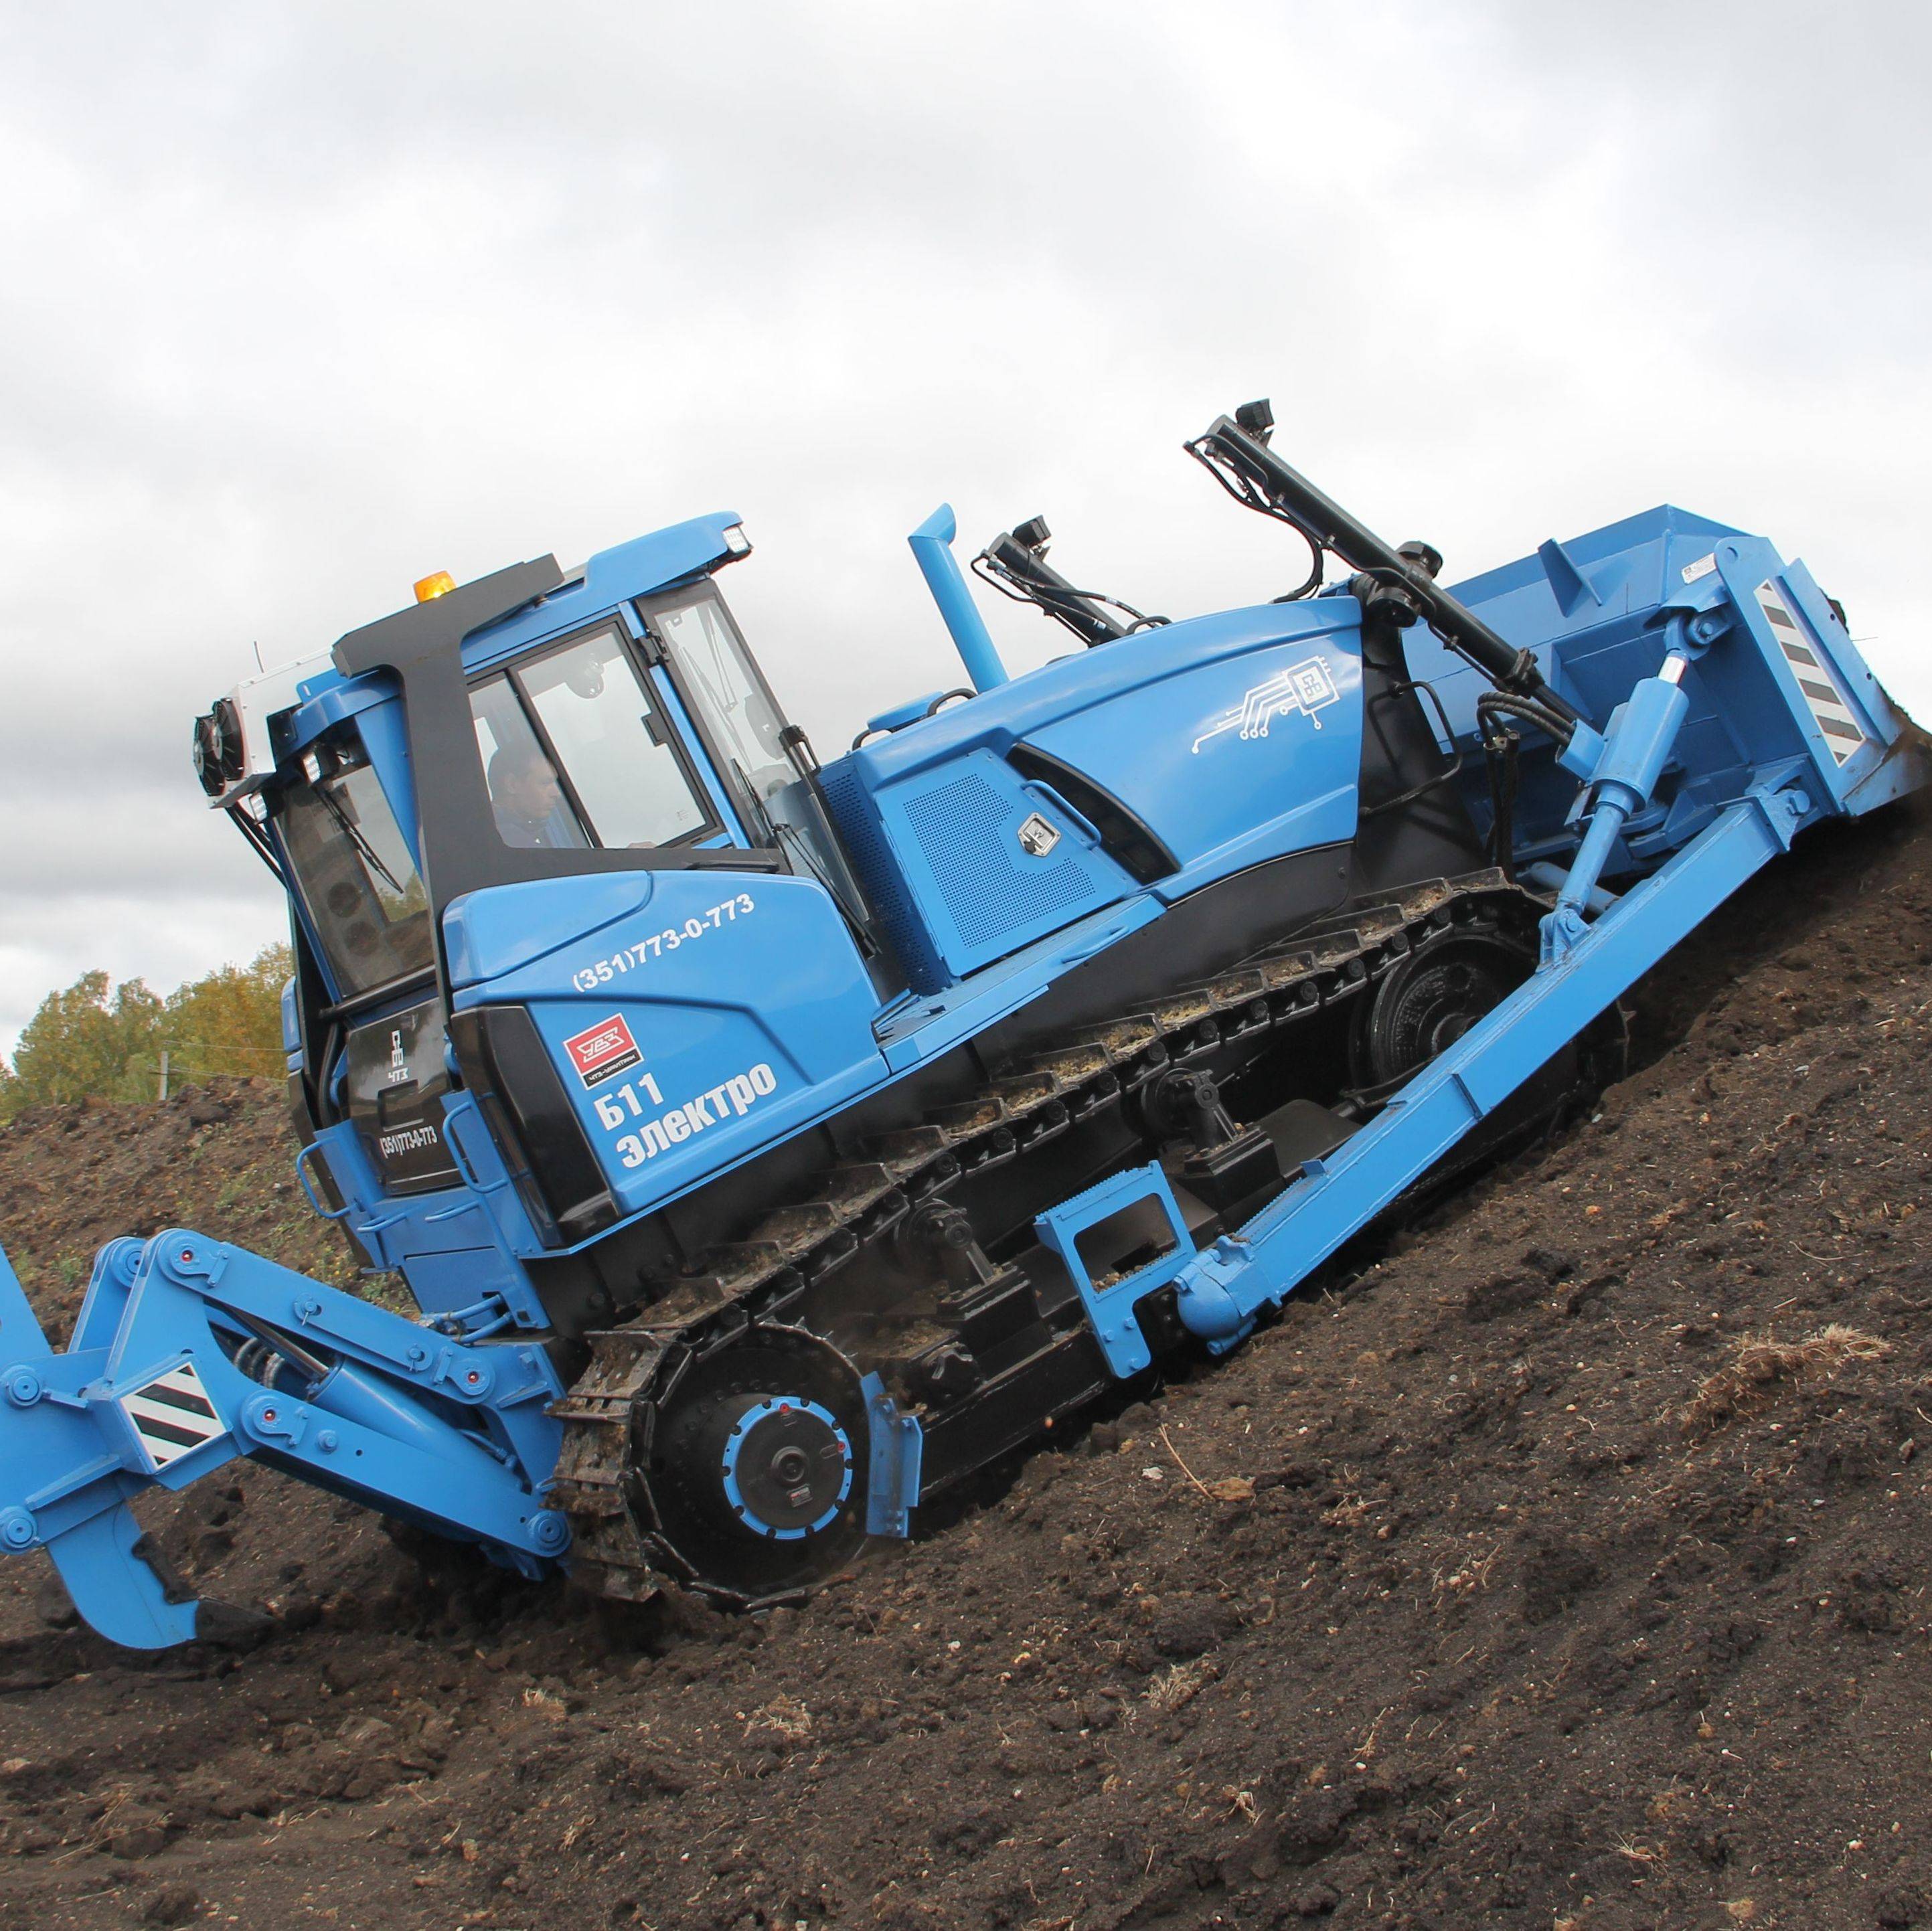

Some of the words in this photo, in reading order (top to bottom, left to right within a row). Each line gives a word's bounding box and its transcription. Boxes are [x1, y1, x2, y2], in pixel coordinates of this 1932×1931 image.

[573, 893, 754, 992] (351)773-0-773
[388, 1068, 408, 1083] ЧТЗ
[588, 1054, 636, 1080] ЧТЗ-УЛТК
[593, 1072, 664, 1131] Б11
[380, 1125, 438, 1159] (351)773-0-773
